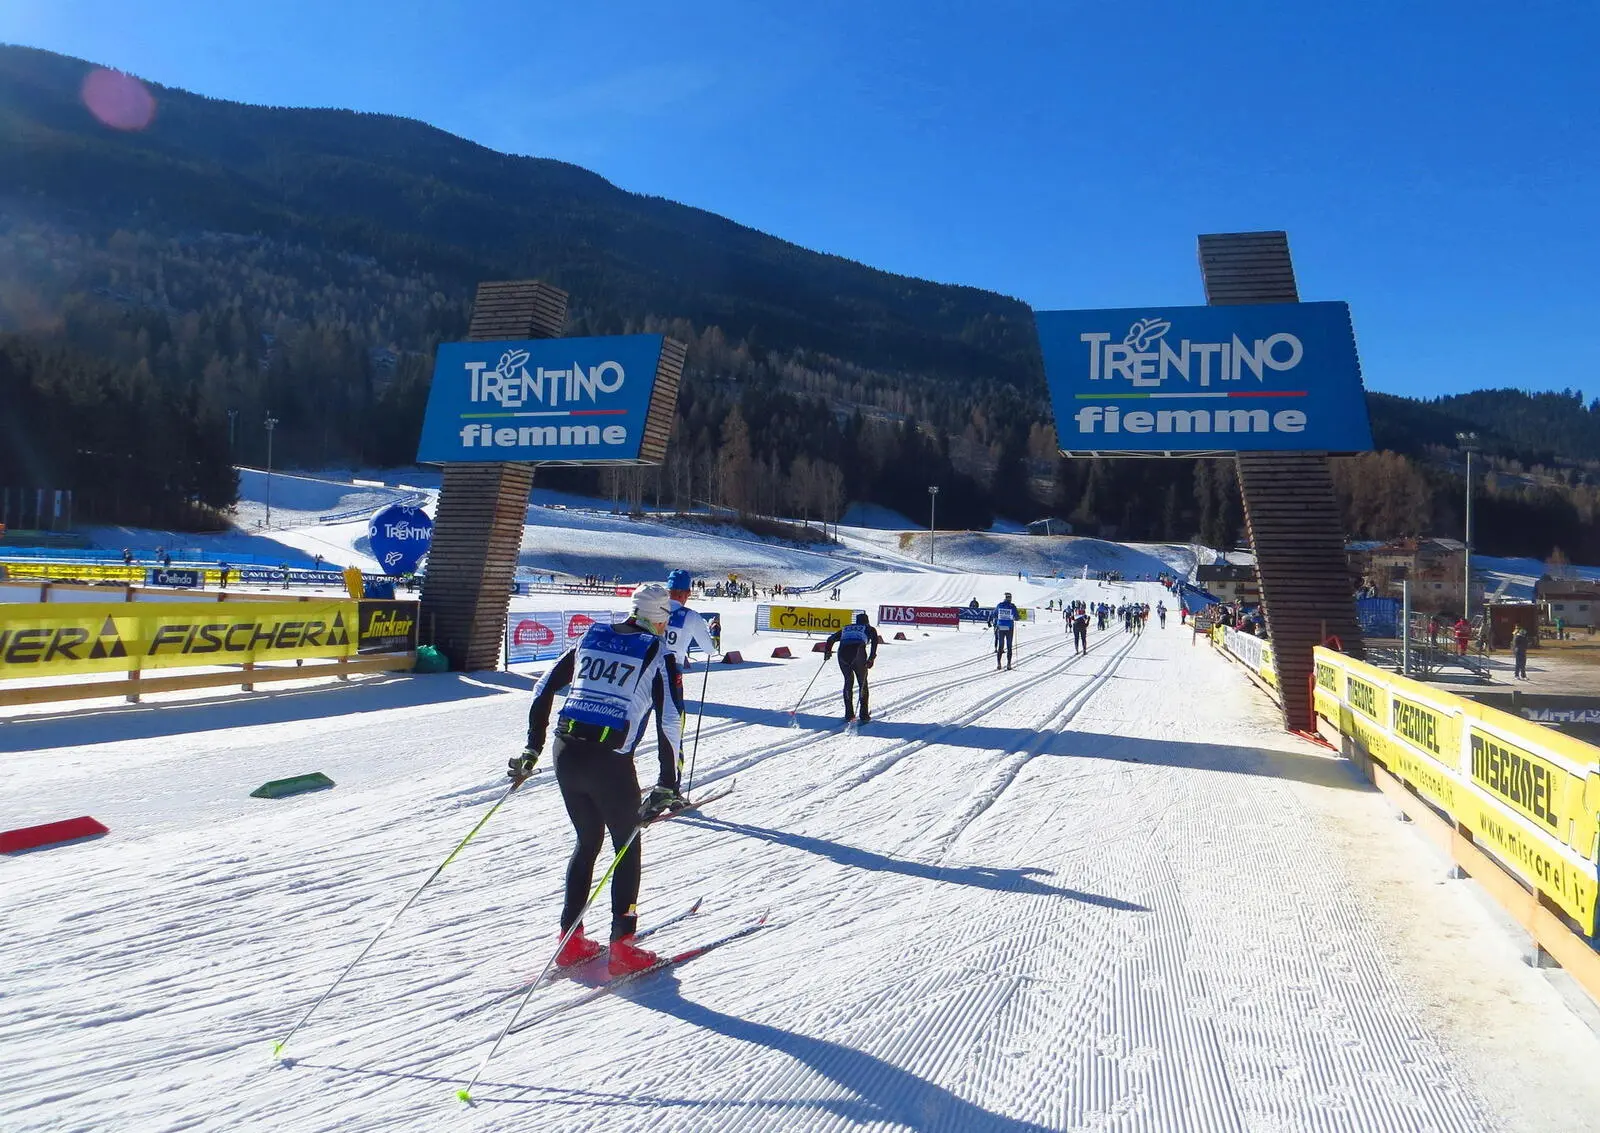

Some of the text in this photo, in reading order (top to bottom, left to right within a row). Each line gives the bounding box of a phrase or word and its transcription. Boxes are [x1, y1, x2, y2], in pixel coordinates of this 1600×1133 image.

[1080, 331, 1303, 387] TRENTINO
[464, 360, 625, 408] TRENTINO
[460, 423, 627, 448] fiemme
[1074, 405, 1307, 433] fiemme
[780, 612, 840, 628] Melinda
[883, 608, 914, 621] ITAS
[148, 621, 327, 656] FISCHER
[578, 656, 635, 687] 2047
[1347, 677, 1377, 718] MISCONEL
[1393, 698, 1440, 754] MISCONEL
[1470, 733, 1558, 828] MISCONEL
